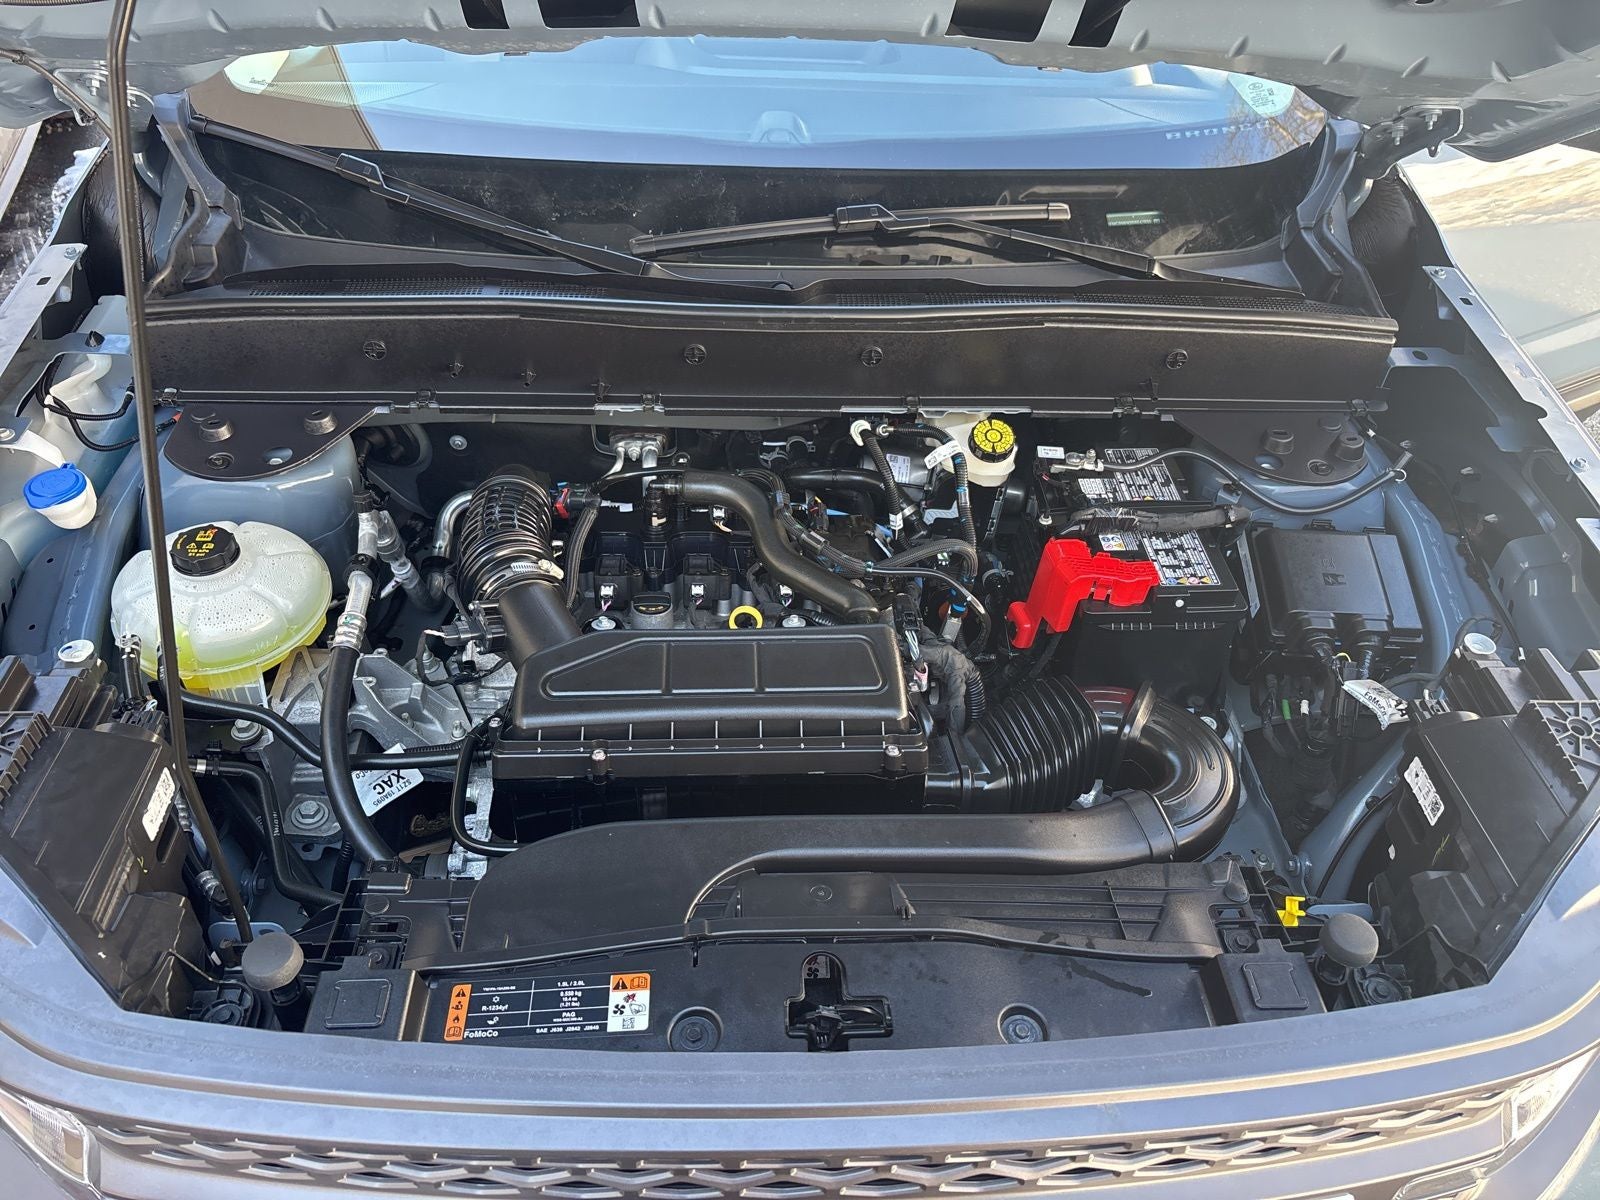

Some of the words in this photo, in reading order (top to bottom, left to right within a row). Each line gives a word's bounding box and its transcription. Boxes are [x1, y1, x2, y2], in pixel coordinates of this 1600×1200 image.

[1364, 691, 1387, 717] FoMoCo
[372, 769, 407, 796] XAC
[372, 790, 395, 807] 19A095
[481, 1004, 508, 1012] R-1234yf
[464, 1030, 499, 1039] FoMoCo
